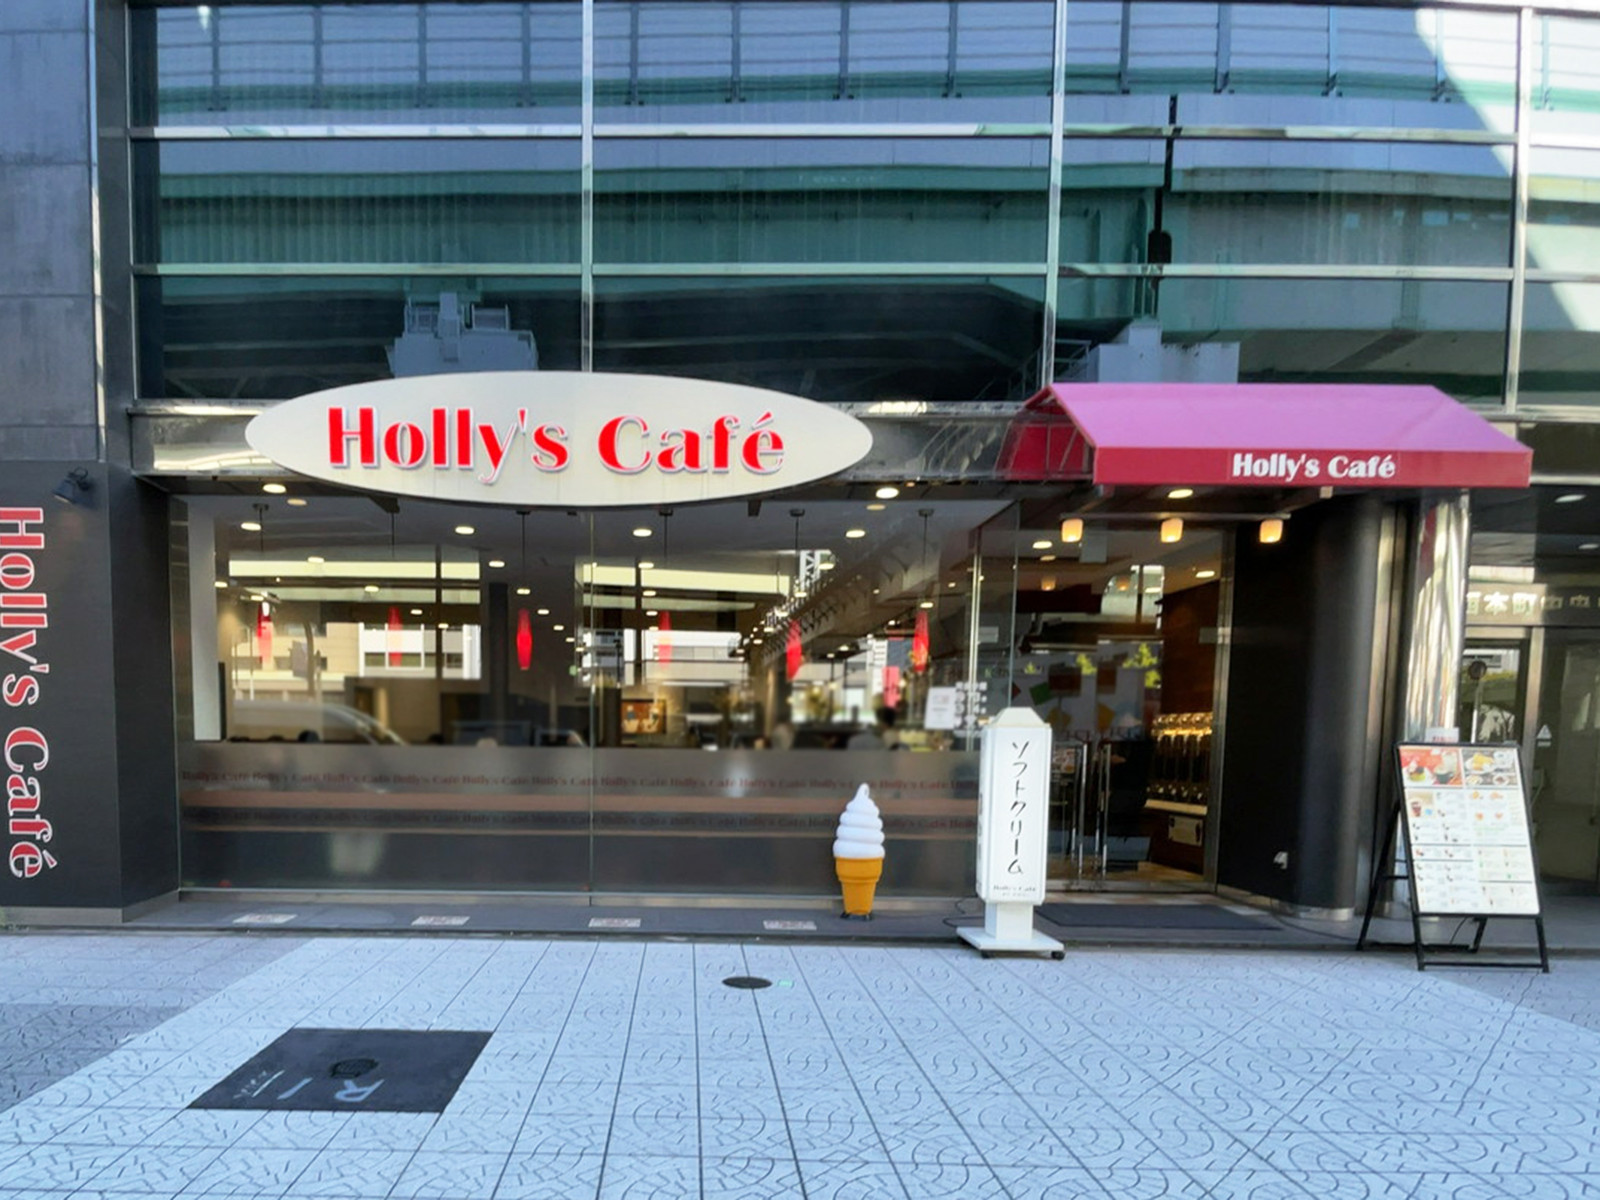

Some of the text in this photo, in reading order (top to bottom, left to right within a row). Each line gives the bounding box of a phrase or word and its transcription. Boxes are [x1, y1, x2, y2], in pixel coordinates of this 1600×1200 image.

[328, 406, 785, 485] Holly's Café
[1232, 453, 1396, 483] Holly's Café
[0, 507, 58, 878] Holly's Café
[1007, 740, 1031, 875] ソフトクリーム
